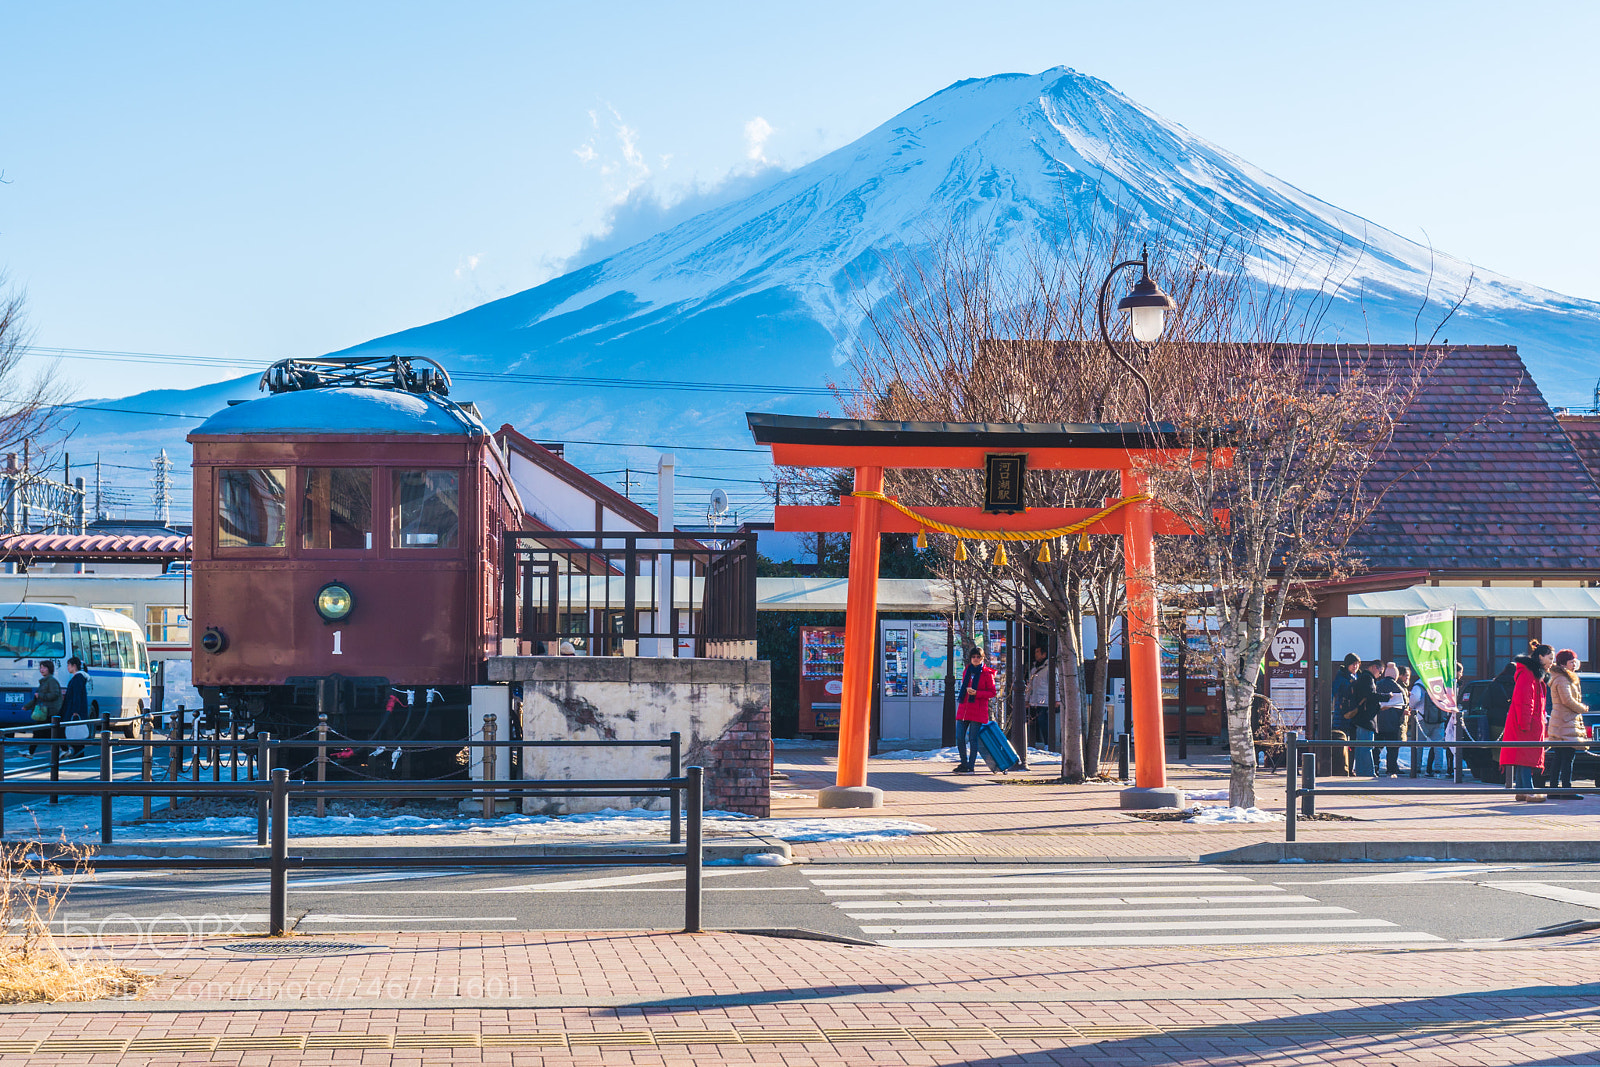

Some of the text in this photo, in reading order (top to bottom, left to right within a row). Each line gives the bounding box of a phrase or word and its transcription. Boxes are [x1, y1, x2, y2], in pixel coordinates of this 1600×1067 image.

[997, 462, 1011, 500] 河口湖駅
[332, 630, 343, 654] 1
[1275, 636, 1300, 645] TAXI
